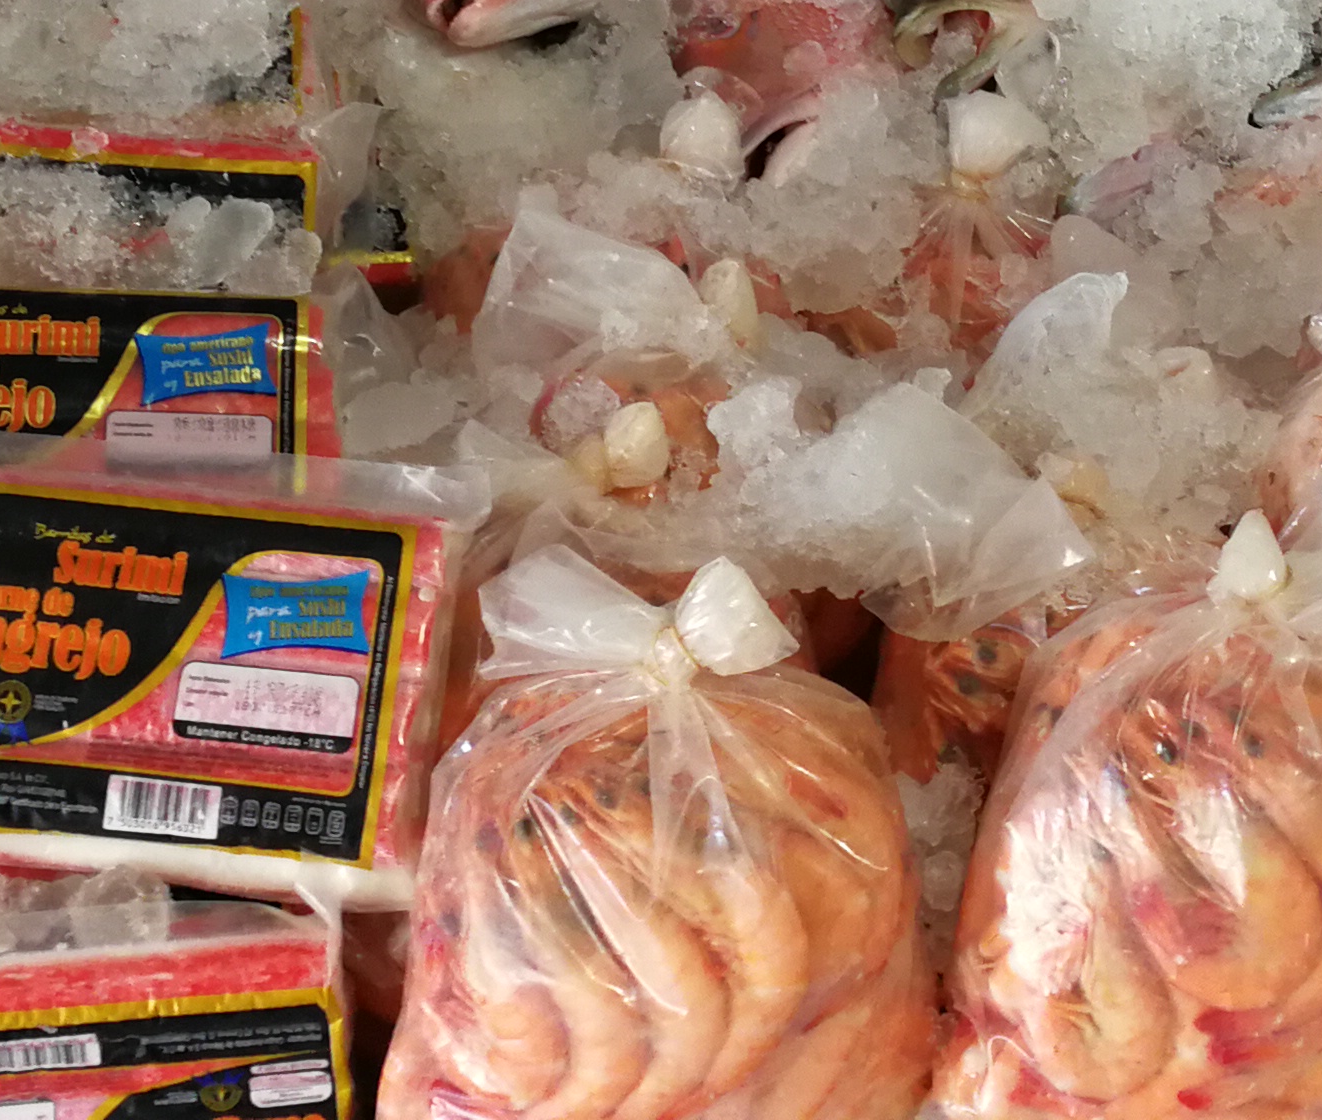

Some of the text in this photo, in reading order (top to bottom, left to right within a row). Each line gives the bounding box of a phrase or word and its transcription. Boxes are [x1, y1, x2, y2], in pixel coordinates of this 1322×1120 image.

[208, 350, 255, 367] Sushi
[184, 366, 263, 388] Ensalada
[53, 540, 189, 596] Surimi
[42, 586, 75, 617] de
[246, 598, 346, 624] para Sushi
[269, 619, 354, 640] Ensalada
[185, 725, 239, 740] Mantener
[240, 730, 301, 747] Congelado
